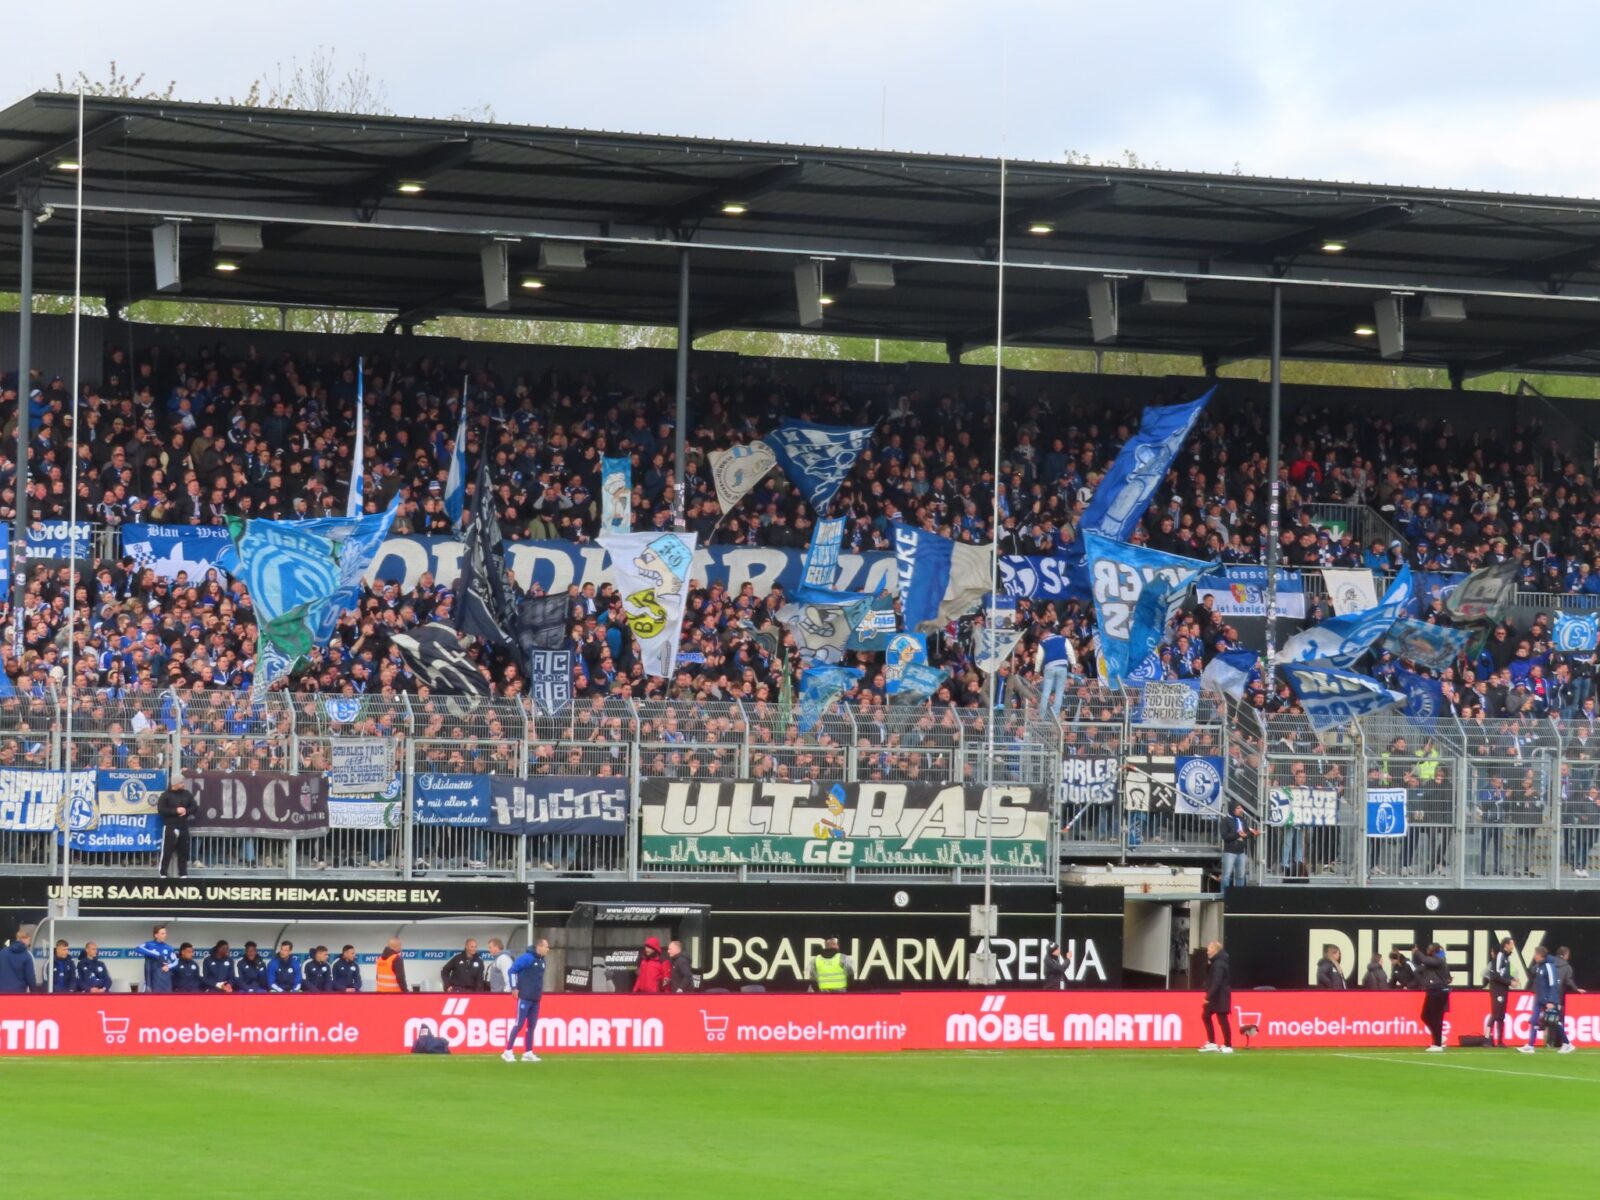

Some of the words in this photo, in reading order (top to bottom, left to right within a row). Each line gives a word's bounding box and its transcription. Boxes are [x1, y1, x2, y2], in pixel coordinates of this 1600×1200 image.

[147, 524, 179, 538] Blau
[88, 833, 134, 846] Schalke
[107, 887, 202, 901] SAARLAND.
[207, 888, 272, 901] UNSERE
[275, 889, 340, 902] HEIMAT.
[343, 889, 406, 903] UNSERE
[410, 890, 441, 903] ELV.
[946, 995, 1055, 1042] MÖBEL
[1064, 1014, 1182, 1042] MARTIN
[0, 1019, 60, 1050] TIN
[139, 1023, 359, 1043] moebel-martin.de
[534, 1018, 664, 1047] MARTIN
